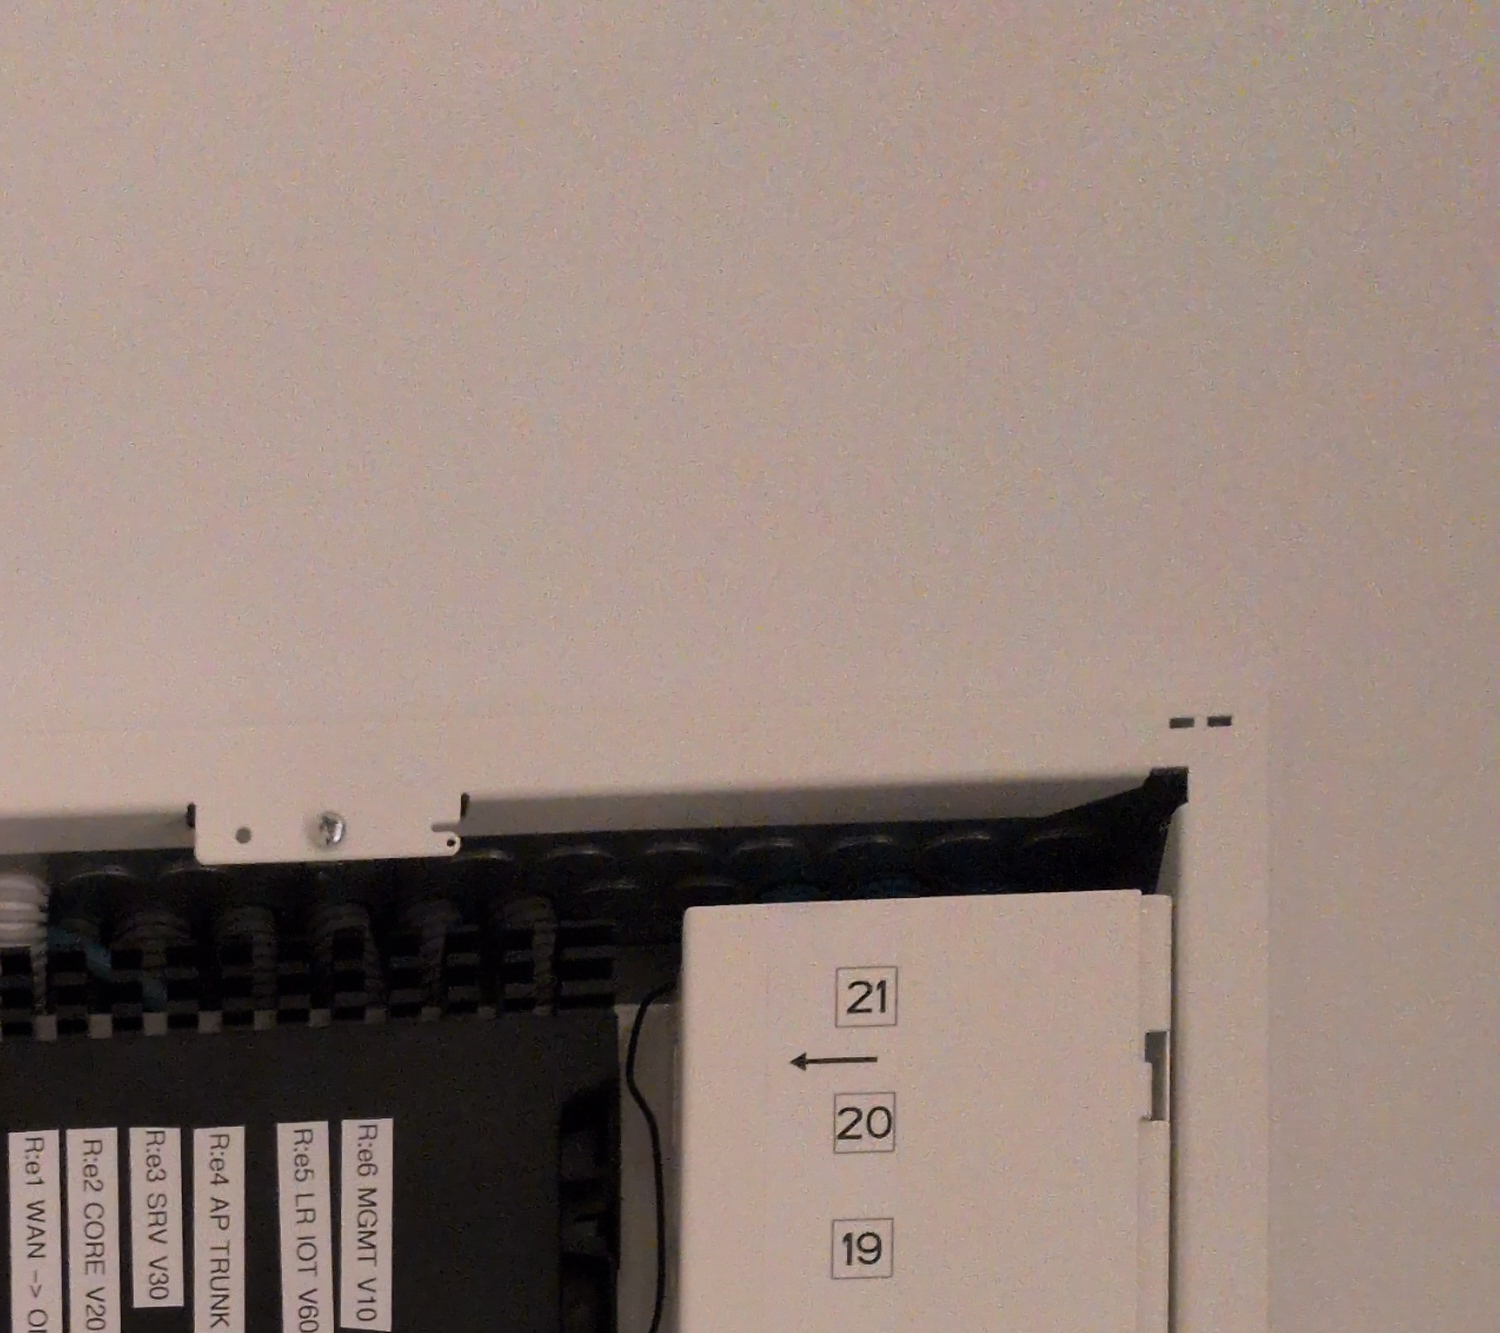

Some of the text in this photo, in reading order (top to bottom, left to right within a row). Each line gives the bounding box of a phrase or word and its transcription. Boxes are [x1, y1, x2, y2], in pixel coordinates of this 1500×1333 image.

[846, 979, 887, 1014] 21
[24, 1136, 45, 1186] R:e1
[836, 1105, 893, 1141] 20
[26, 1199, 46, 1259] WAN
[82, 1139, 106, 1331] R:e2 CORE V20
[145, 1130, 170, 1301] R:e3 SRV V30
[209, 1133, 231, 1329] R:e4 AP TRUNK
[293, 1128, 320, 1333] R:e5 LR IOT V60
[356, 1124, 379, 1322] R:e6 MGMT V10
[842, 1231, 883, 1266] 19
